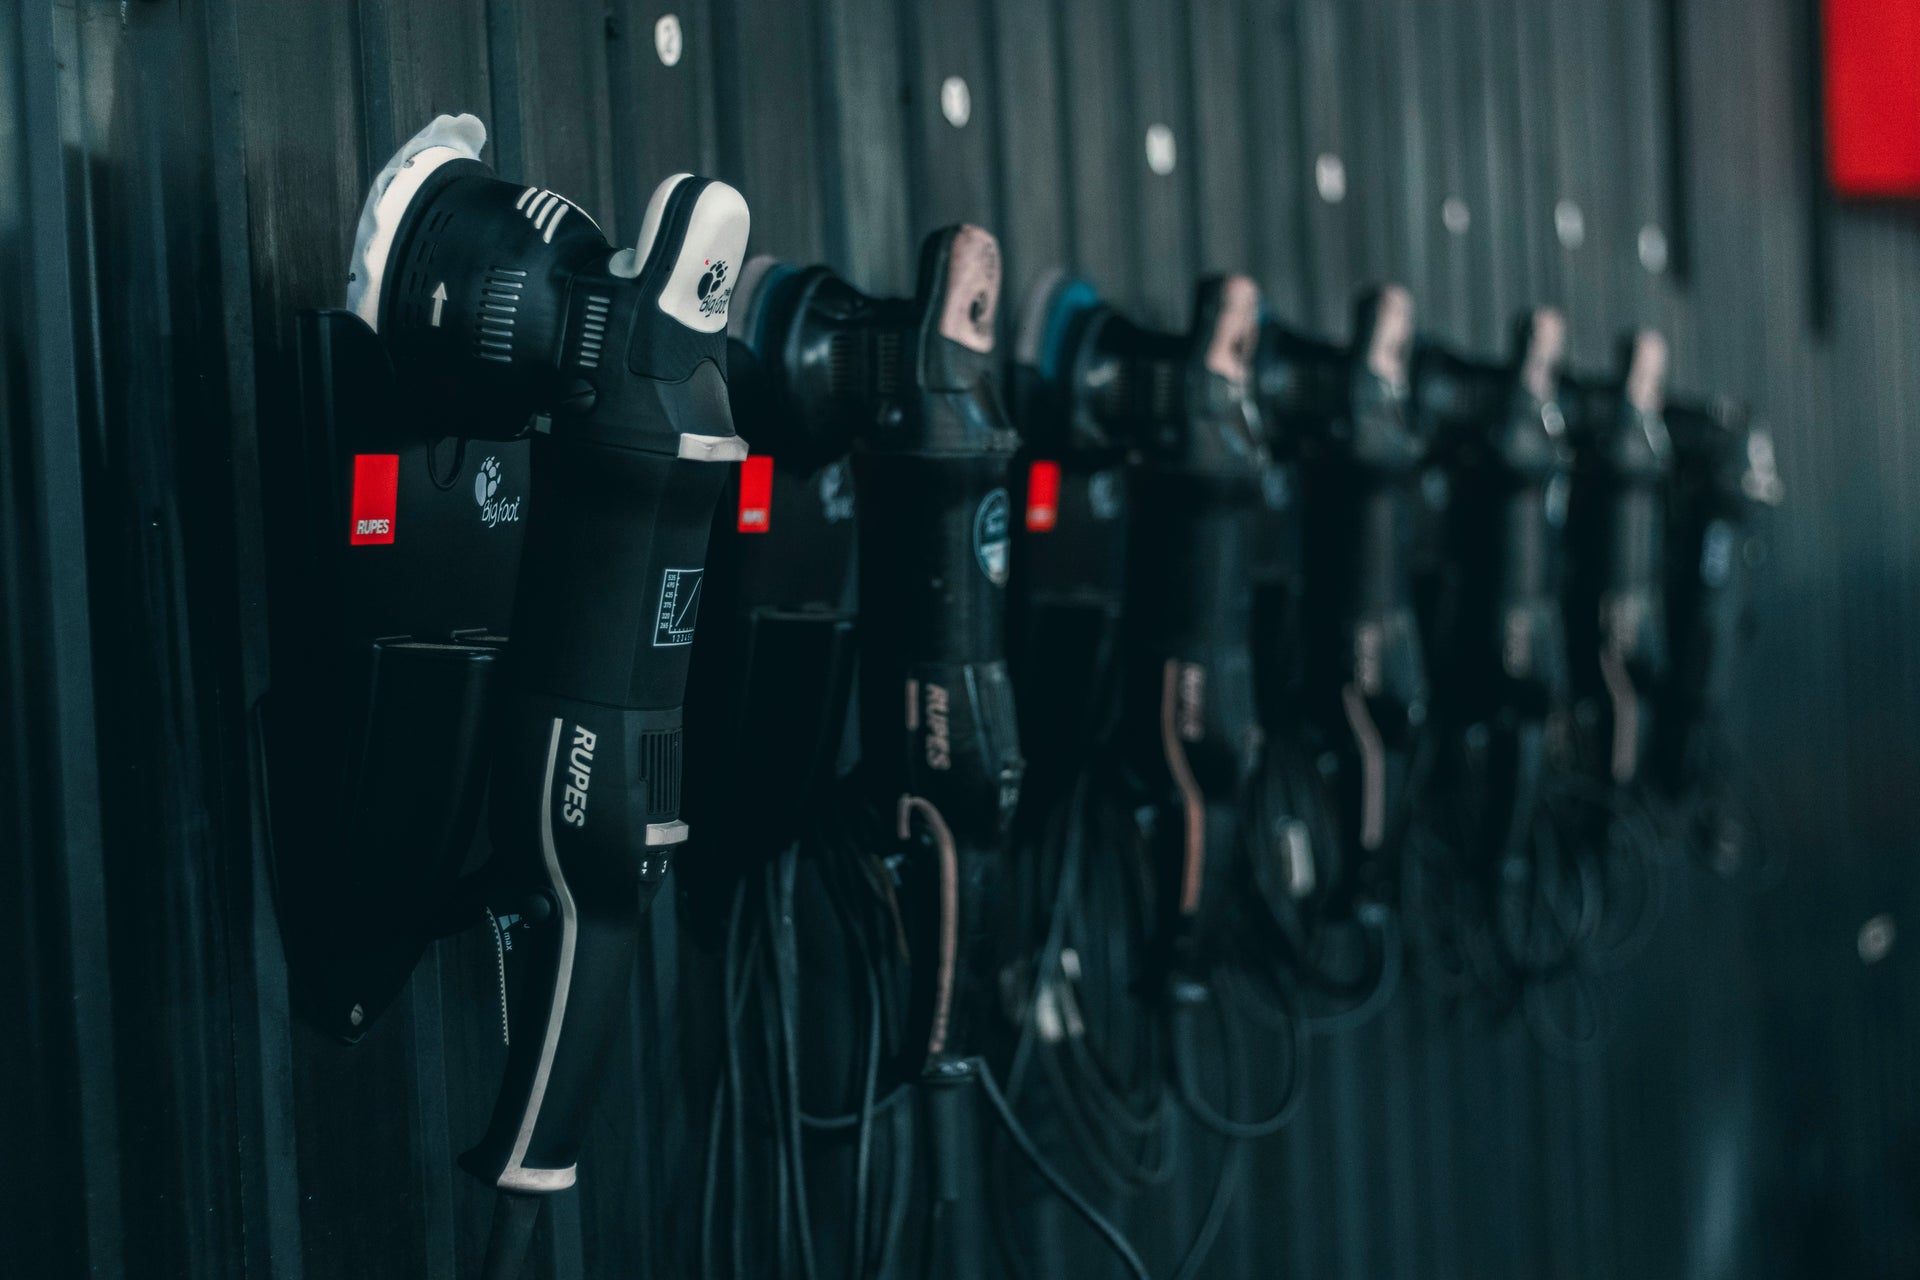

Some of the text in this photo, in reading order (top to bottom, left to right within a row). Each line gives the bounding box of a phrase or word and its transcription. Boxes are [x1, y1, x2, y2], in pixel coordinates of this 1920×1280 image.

[356, 519, 390, 535] RUPES
[563, 724, 597, 827] RUPES
[503, 931, 513, 951] max
